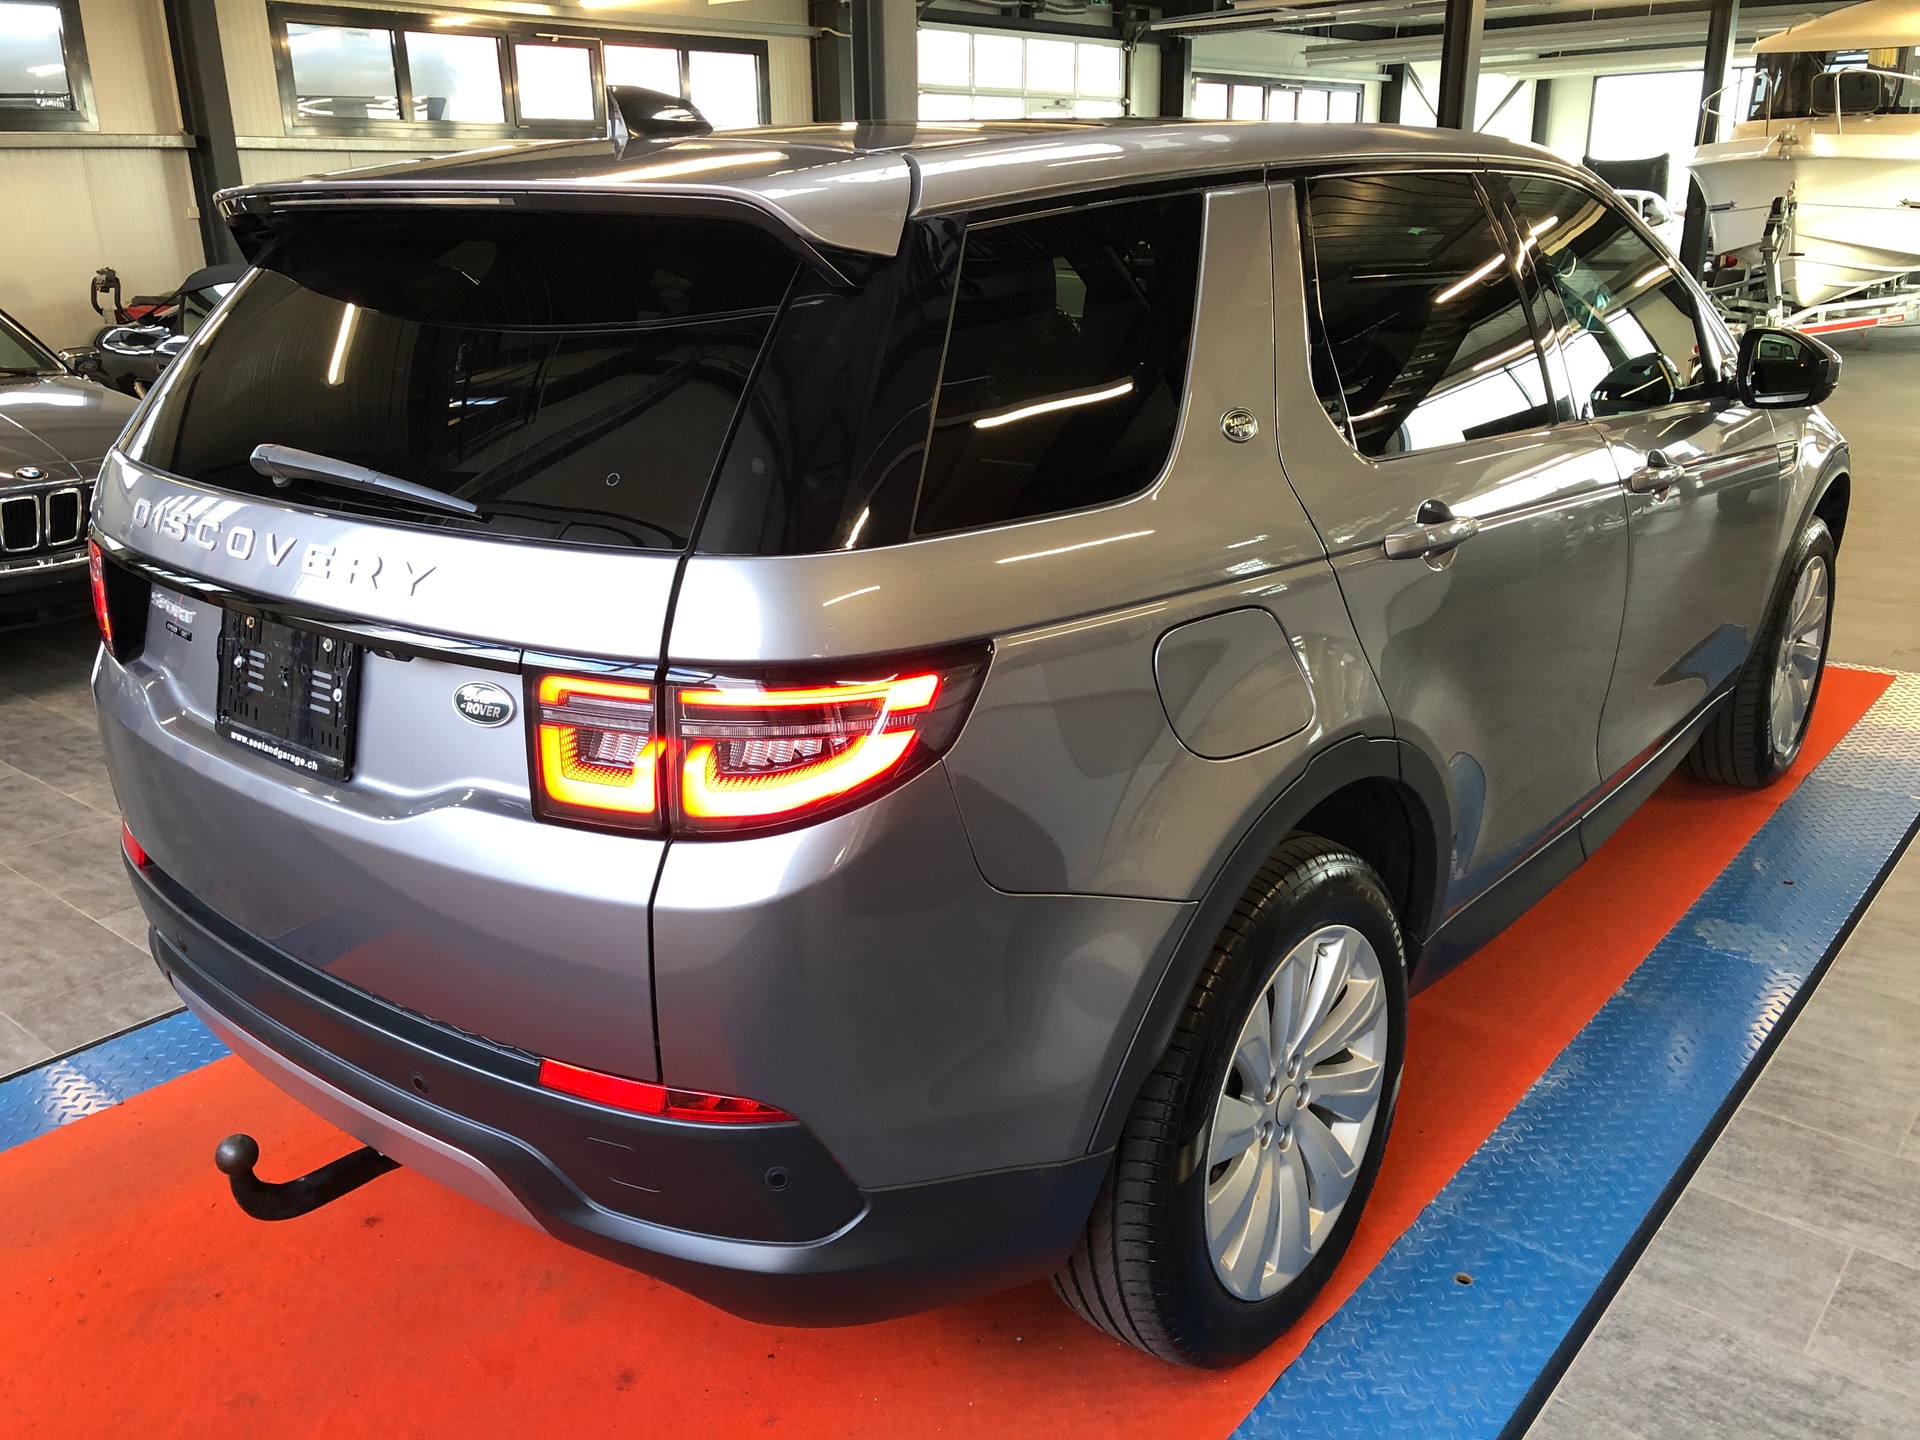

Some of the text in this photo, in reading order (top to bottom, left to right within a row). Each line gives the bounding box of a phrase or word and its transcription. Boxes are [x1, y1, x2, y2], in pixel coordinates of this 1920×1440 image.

[131, 497, 437, 596] DISCOVERY
[465, 701, 502, 719] ROVER
[230, 731, 318, 771] www.seelandgarage.ch
